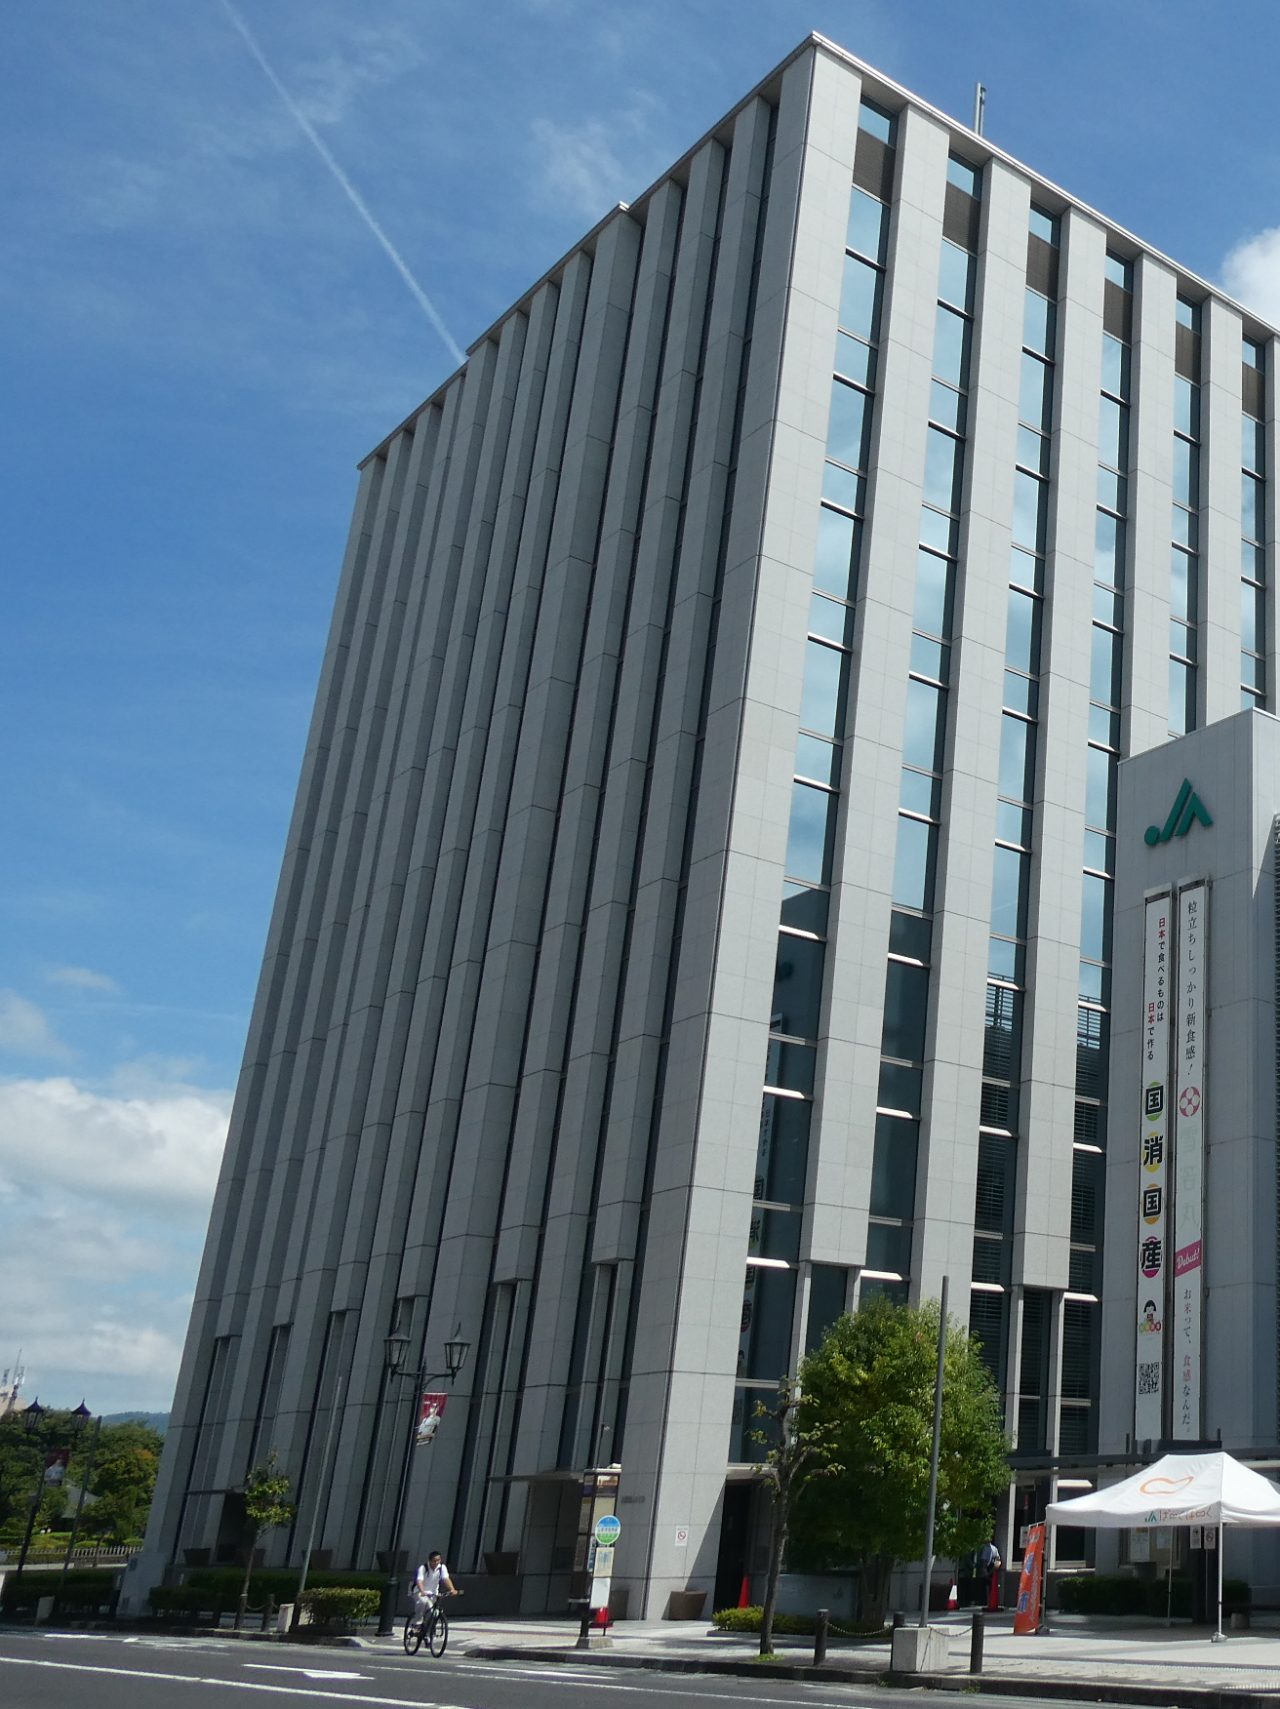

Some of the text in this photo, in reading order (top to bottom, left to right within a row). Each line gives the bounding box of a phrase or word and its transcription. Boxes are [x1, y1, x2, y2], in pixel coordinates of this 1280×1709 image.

[1157, 918, 1166, 1022] 日本で食べるものは
[1147, 1002, 1155, 1060] 日本で作る
[1141, 1085, 1164, 1270] 国消国産
